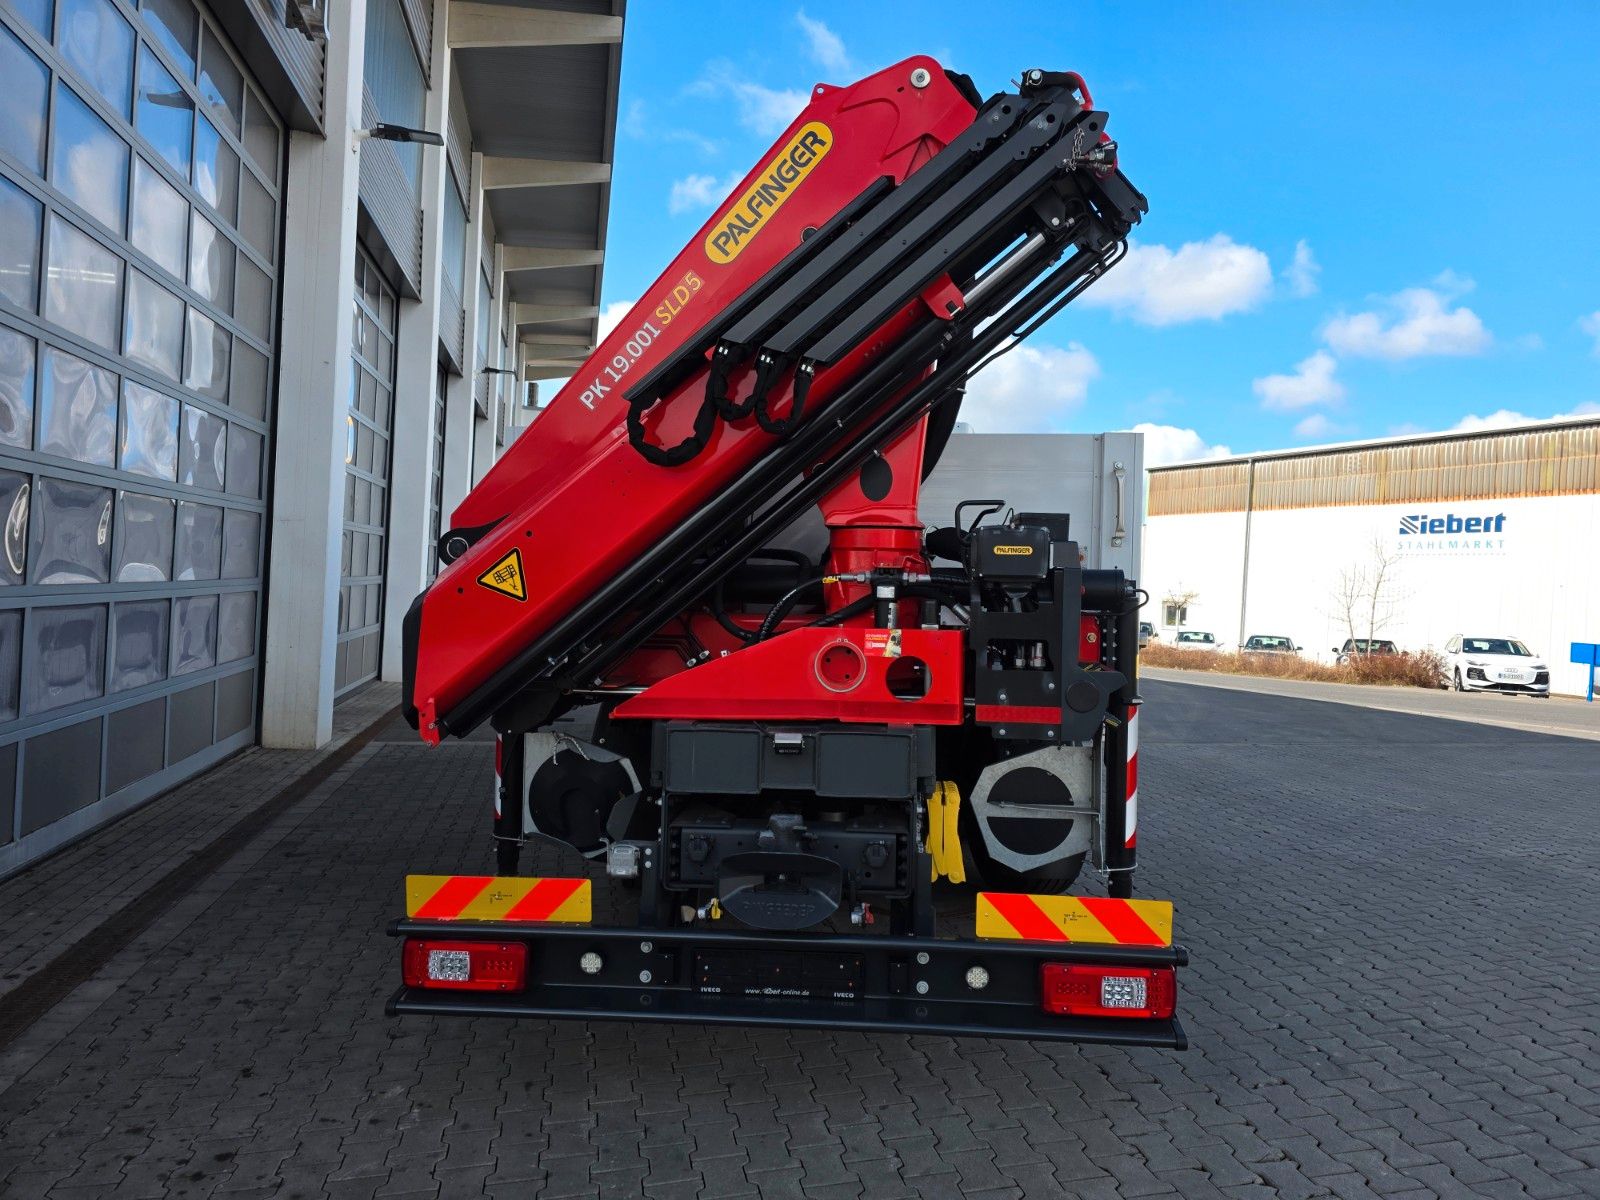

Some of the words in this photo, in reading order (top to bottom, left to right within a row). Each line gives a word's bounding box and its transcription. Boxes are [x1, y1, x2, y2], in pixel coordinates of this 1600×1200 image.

[711, 130, 828, 257] PALFINGER
[579, 377, 612, 411] PK
[604, 321, 661, 383] 19.001
[1397, 539, 1505, 550] STAHLMARKT
[1399, 512, 1507, 535] Siebert
